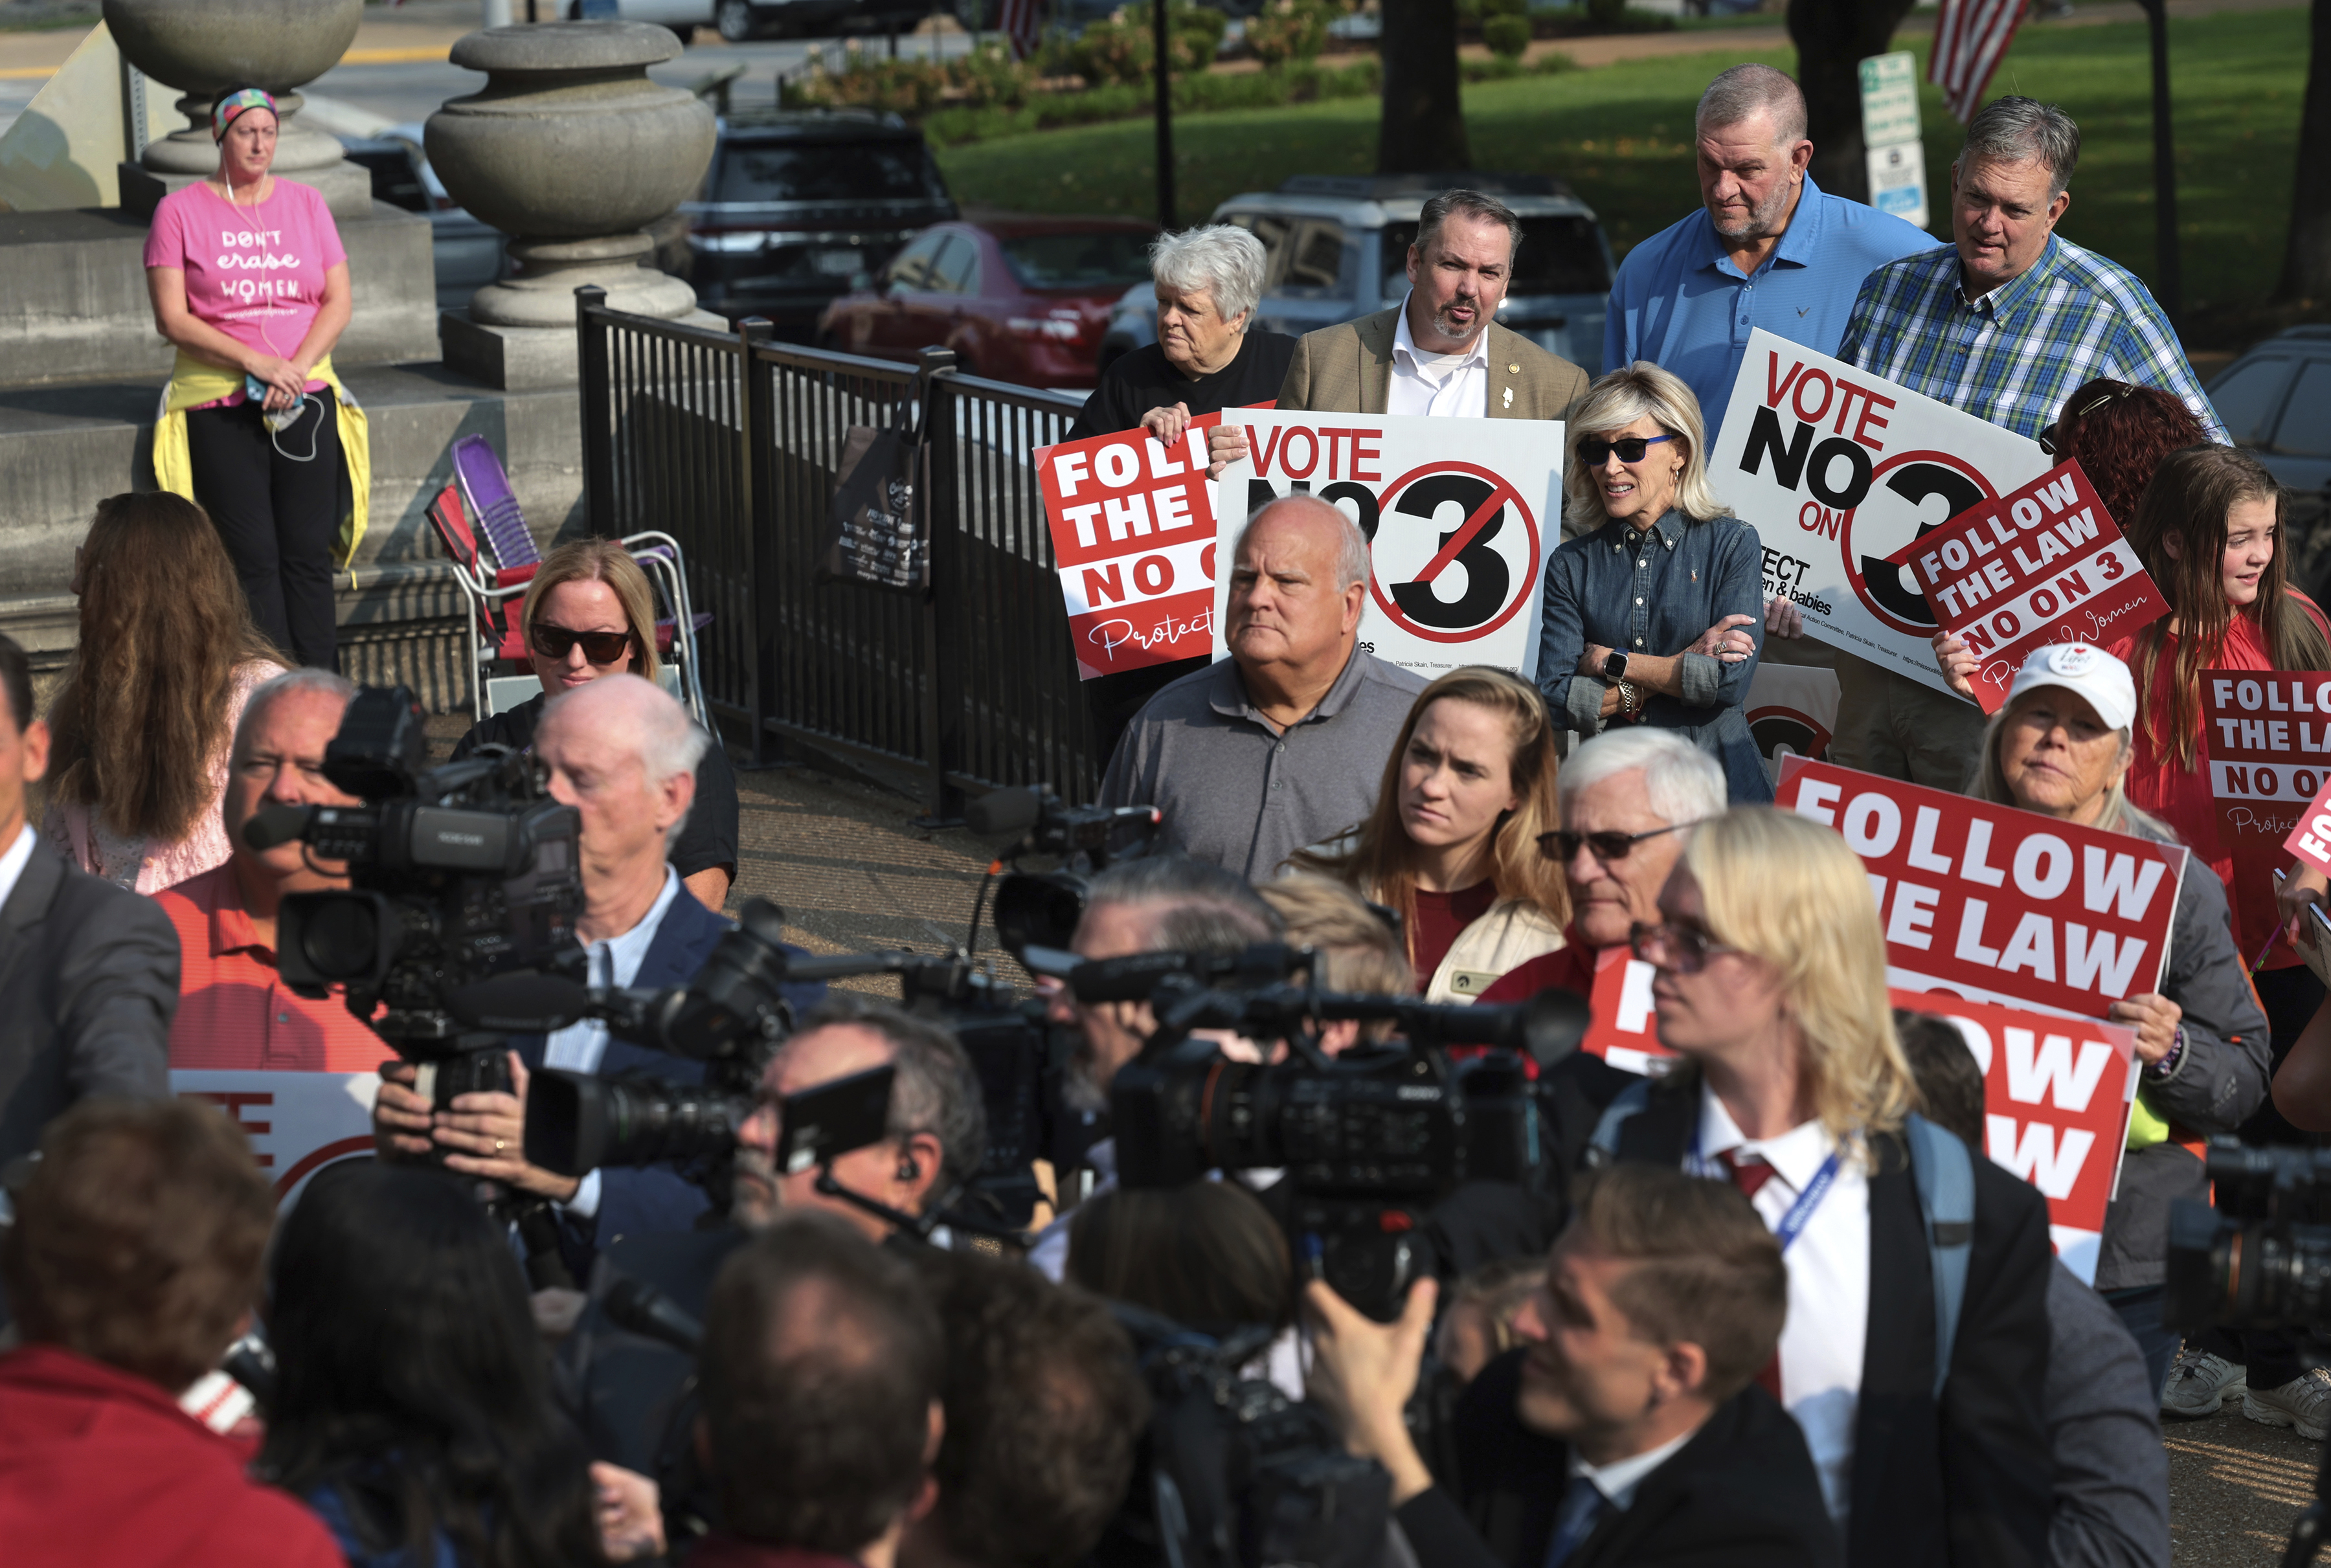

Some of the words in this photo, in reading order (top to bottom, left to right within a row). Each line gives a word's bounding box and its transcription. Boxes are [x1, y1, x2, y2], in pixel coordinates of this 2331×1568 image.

[216, 252, 301, 270] erase
[221, 230, 282, 248] DON'T
[1767, 350, 1897, 452] VOTE
[1244, 424, 1383, 482] VOTE
[1739, 405, 1873, 510] NO
[1061, 484, 1193, 548] THE
[1799, 501, 1843, 541] ON
[1919, 472, 2079, 585] FOLLOW
[1389, 475, 1510, 629] 3
[1935, 557, 2015, 618] THE
[2011, 506, 2099, 576] LAW
[1081, 554, 1175, 609] NO
[1789, 585, 1832, 616] babies
[1961, 610, 2021, 655] NO
[2029, 569, 2091, 618] ON
[2095, 552, 2124, 581] 3
[1088, 606, 1213, 661] Protect
[1806, 614, 1820, 624] Action
[1820, 620, 1845, 636] Committee,
[1845, 631, 1862, 643] Patricia
[1862, 638, 1876, 649] Skain,
[1876, 644, 1898, 658] Treasurer.
[2216, 718, 2290, 751] THE
[2225, 766, 2279, 796] NO
[1795, 777, 2167, 922] FOLLOW
[1954, 897, 2148, 999] LAW
